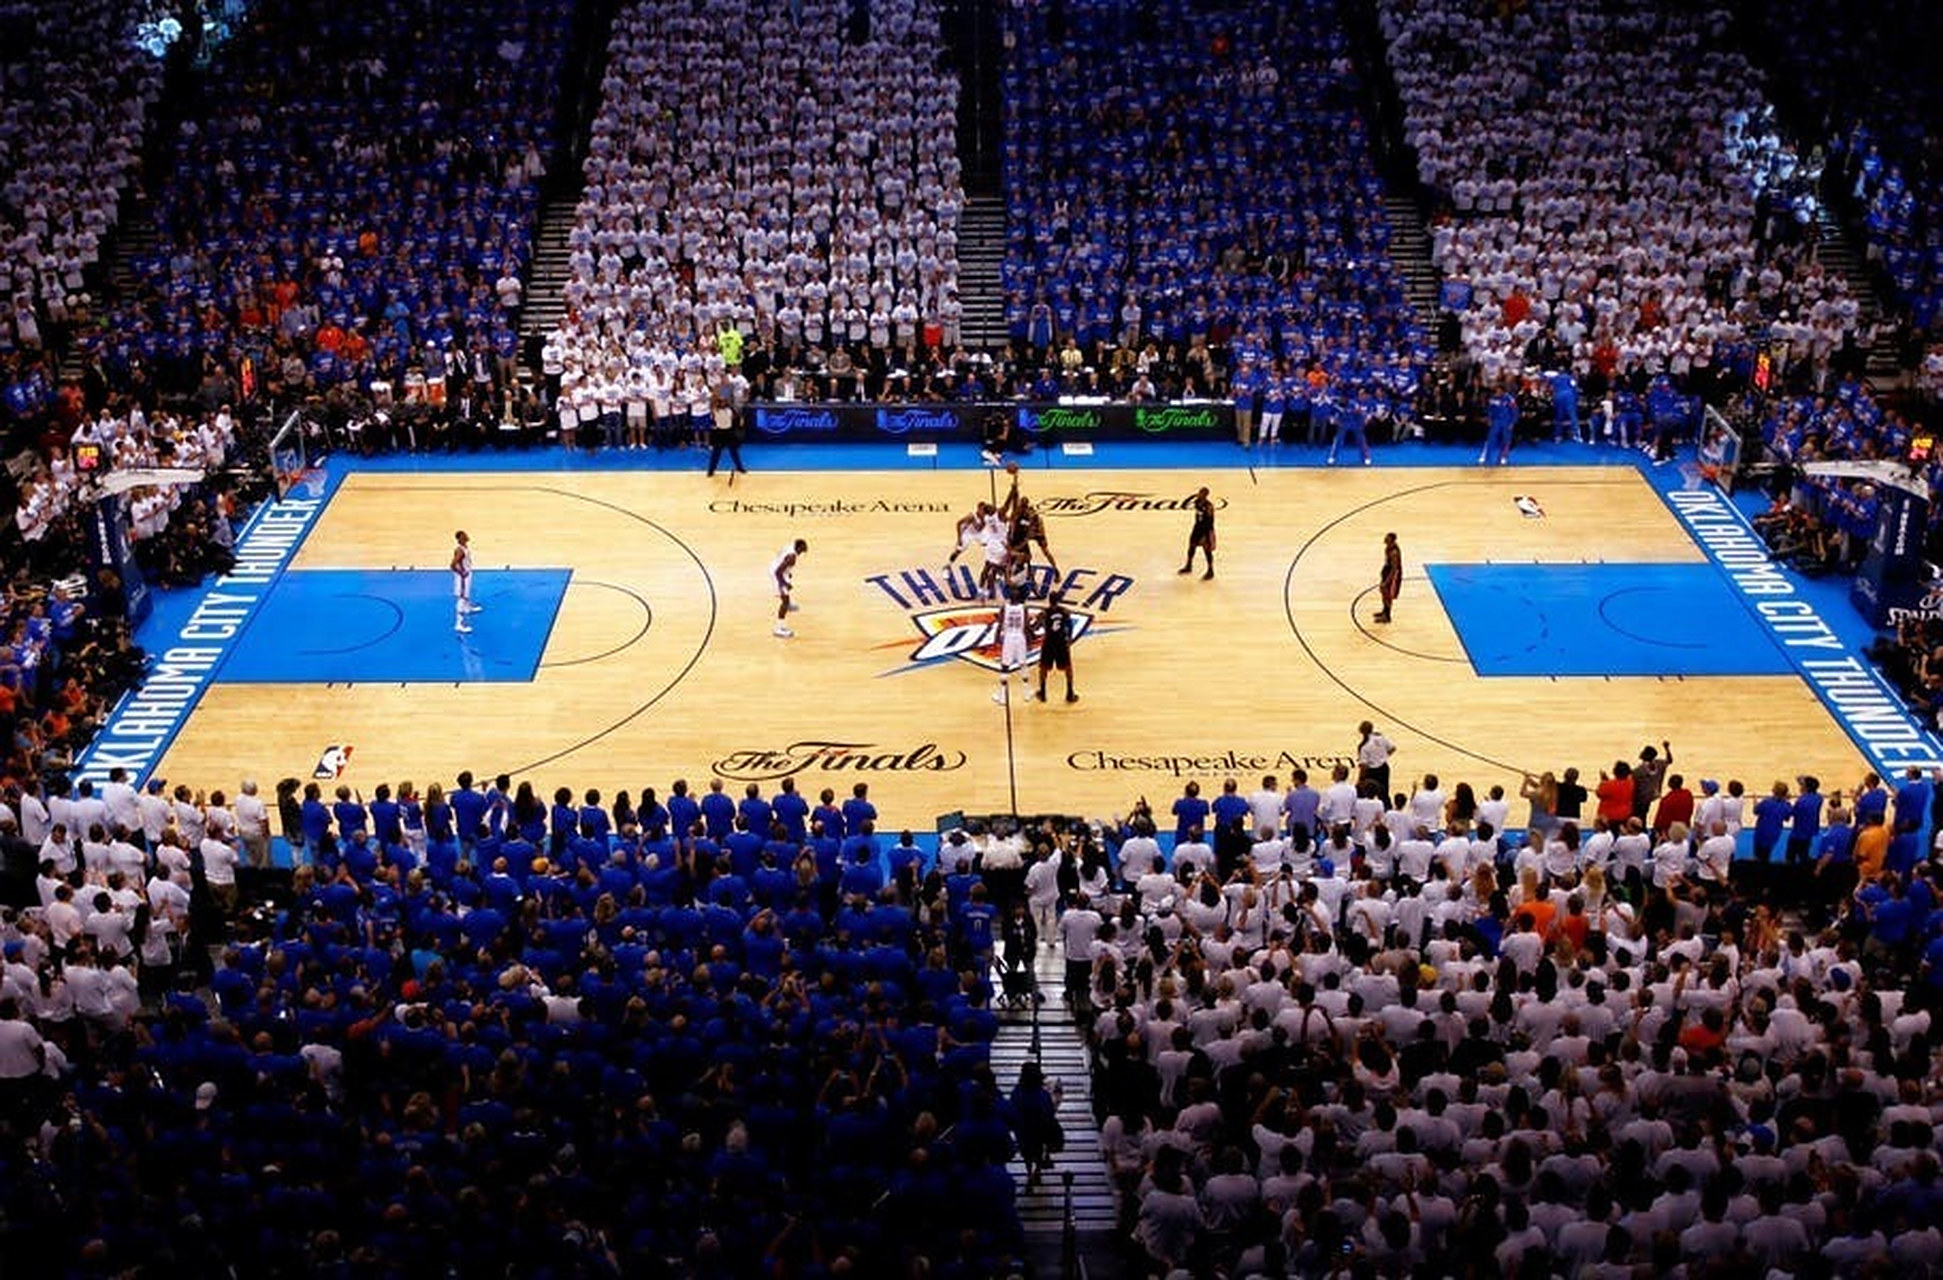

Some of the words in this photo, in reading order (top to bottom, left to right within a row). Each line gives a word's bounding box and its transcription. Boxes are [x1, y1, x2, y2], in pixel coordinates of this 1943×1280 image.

[708, 499, 866, 517] Chesapeake
[869, 500, 951, 513] Arena
[1085, 491, 1228, 515] Final
[215, 499, 321, 586] THUNDER
[1667, 491, 1795, 595] OKLAHOMA
[1756, 601, 1844, 649] CITY
[180, 592, 258, 640] CITY
[73, 647, 223, 790] OKLAHOMA
[721, 750, 792, 771] The
[786, 741, 967, 772] Finals
[1066, 750, 1267, 777] Chesapeake
[1273, 751, 1358, 770] Aren
